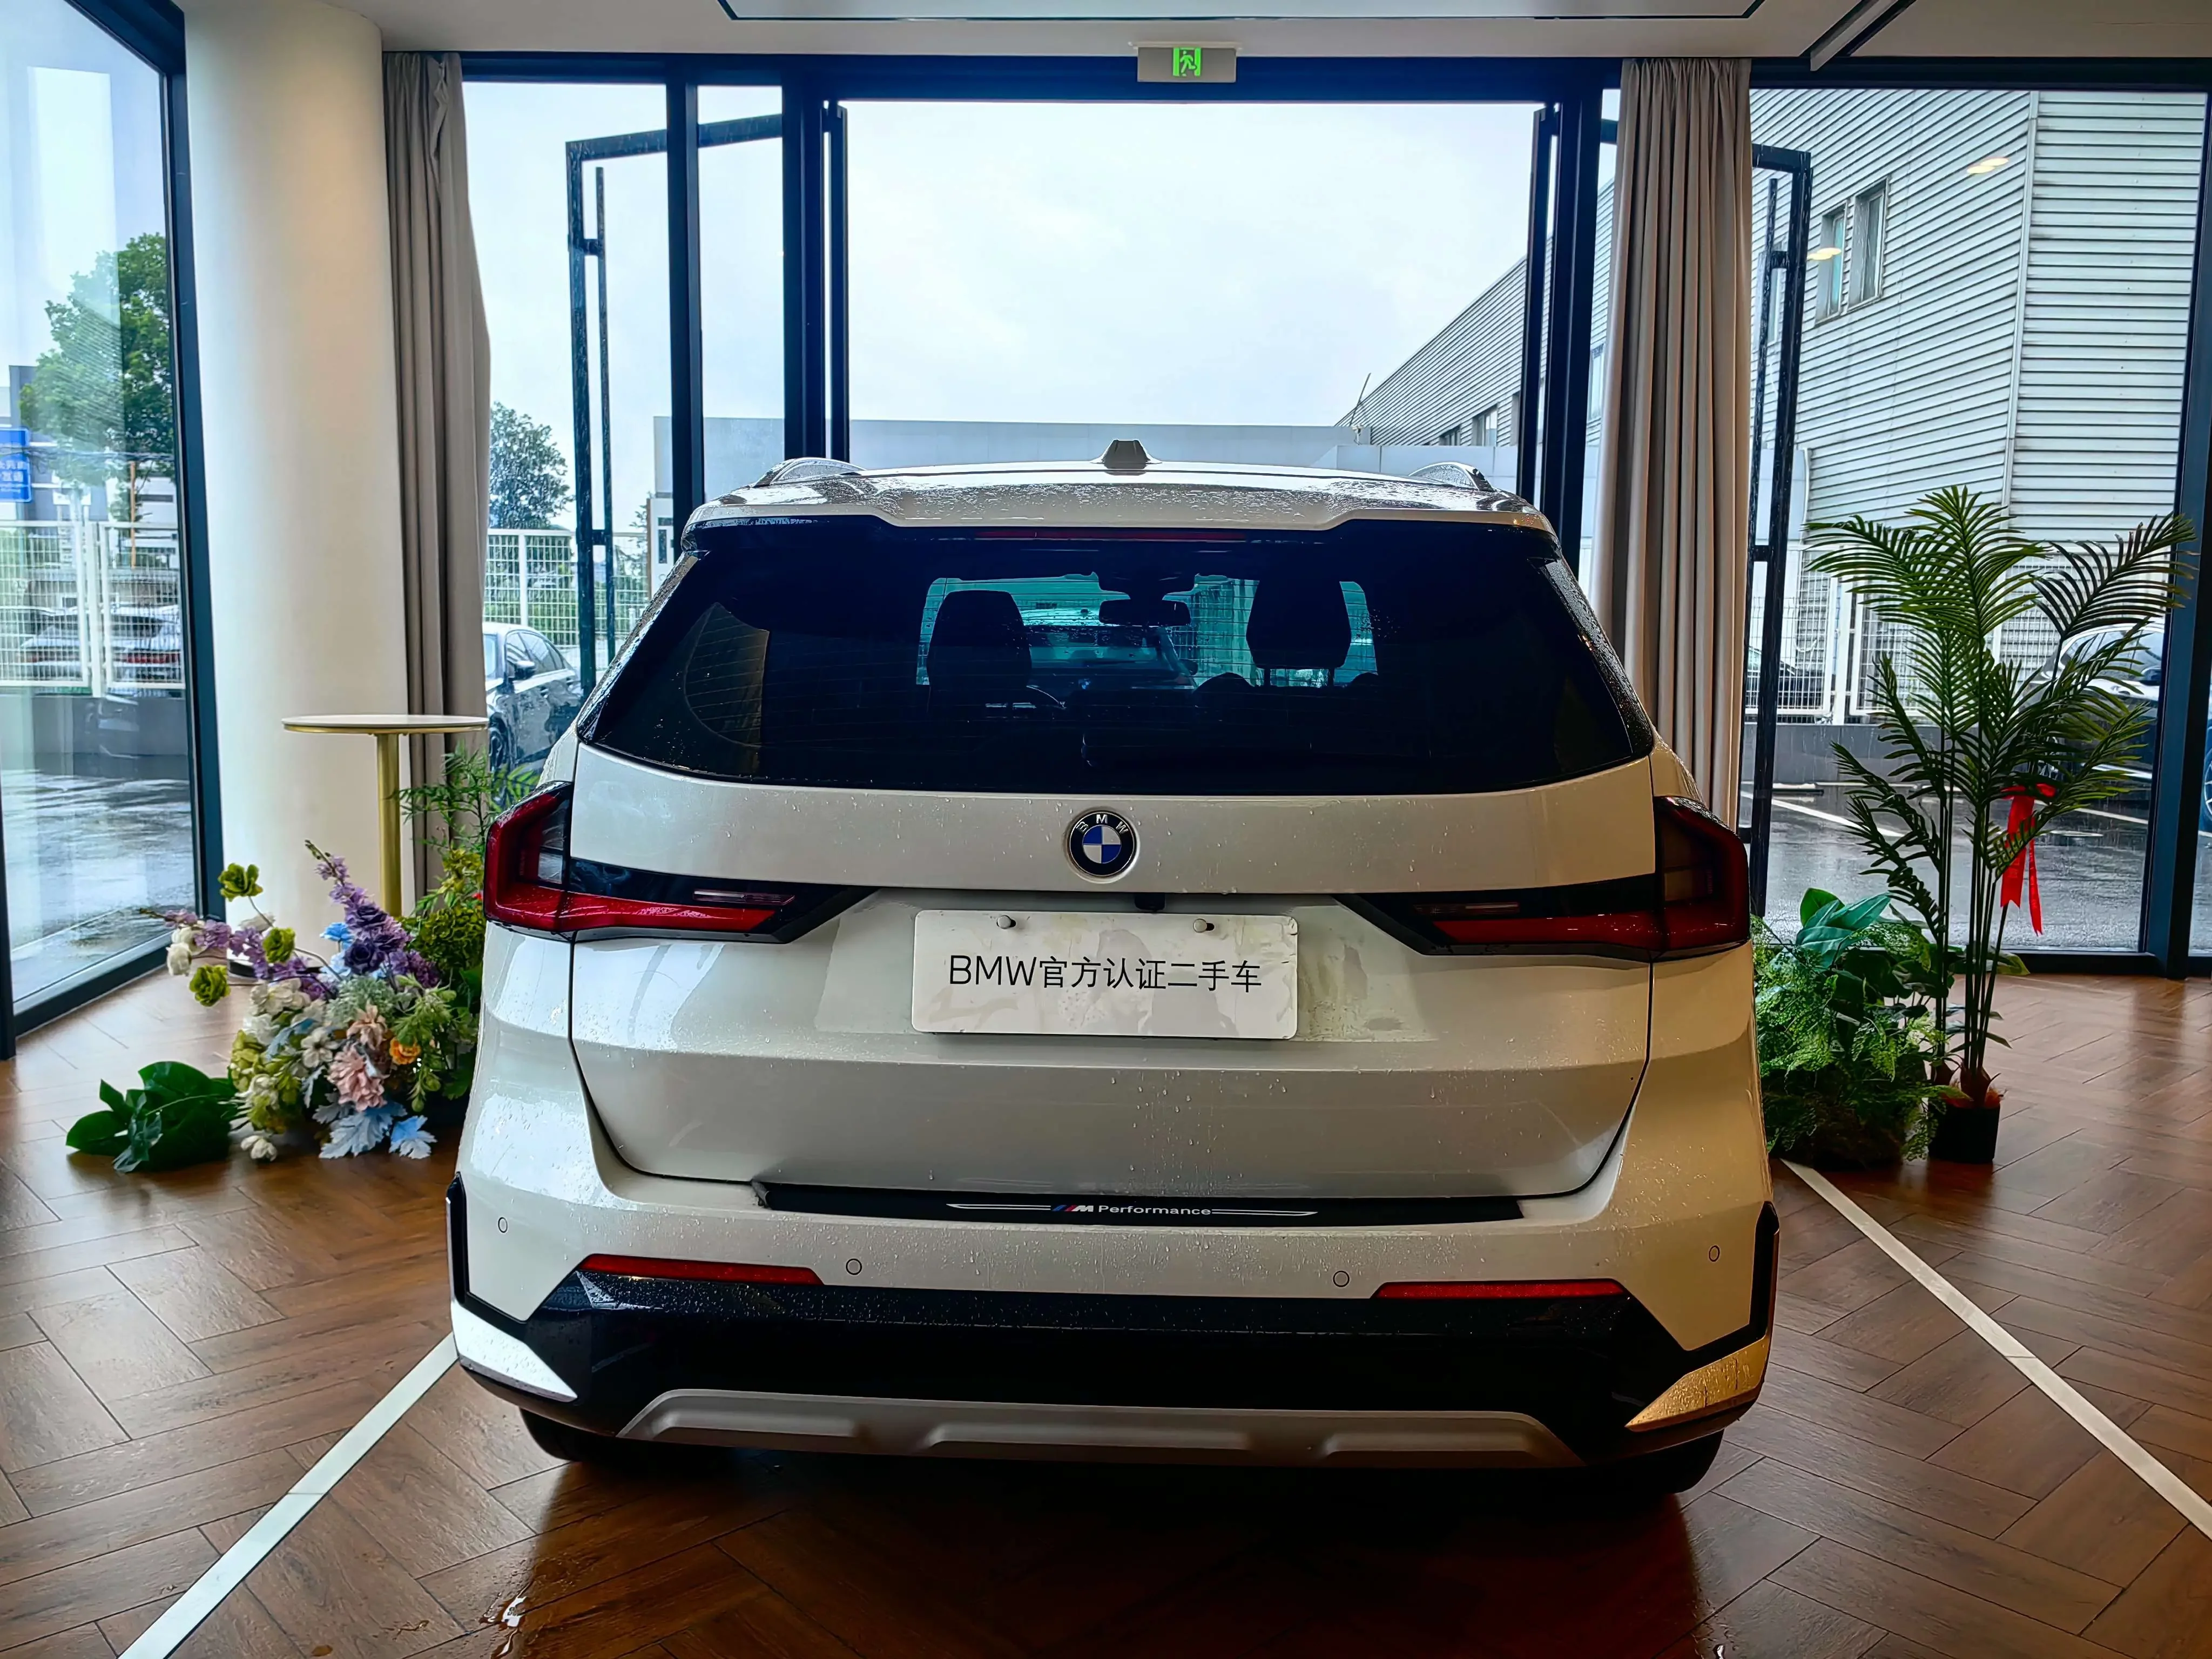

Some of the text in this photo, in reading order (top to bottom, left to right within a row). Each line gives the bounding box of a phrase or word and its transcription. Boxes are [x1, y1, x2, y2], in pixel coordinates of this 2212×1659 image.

[1076, 814, 1129, 834] BMW
[949, 954, 1262, 993] BMW官方认证二手车
[1098, 1205, 1211, 1215] Performance
